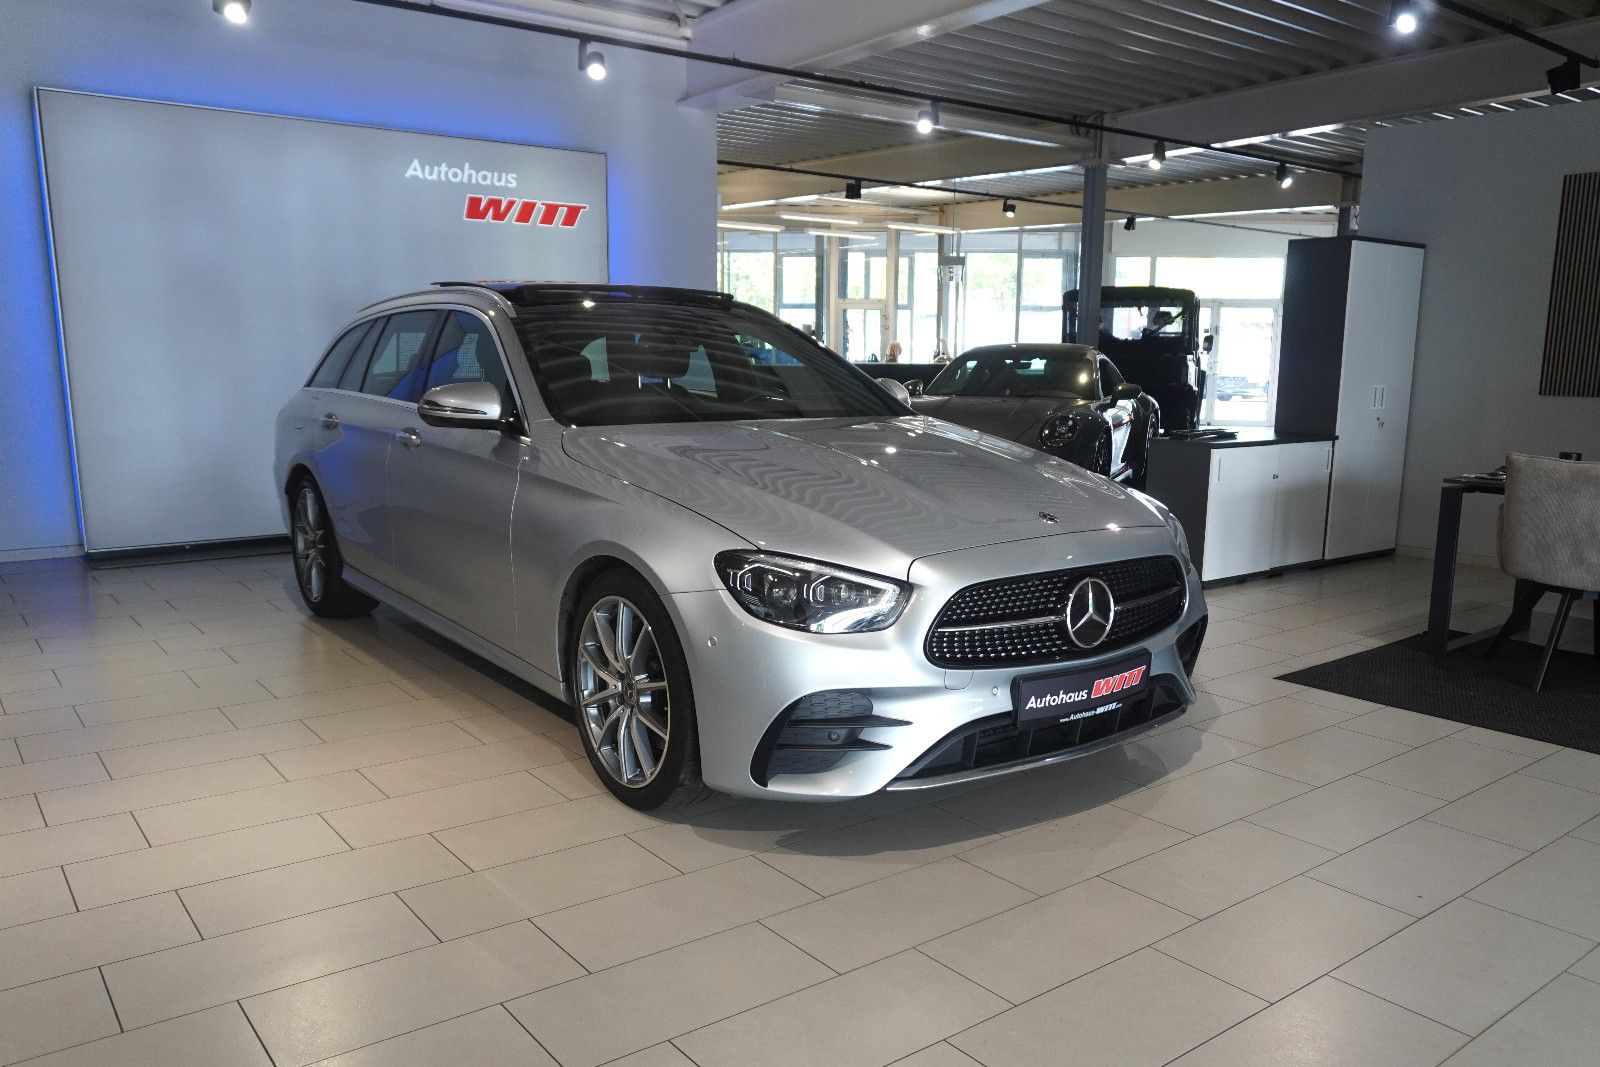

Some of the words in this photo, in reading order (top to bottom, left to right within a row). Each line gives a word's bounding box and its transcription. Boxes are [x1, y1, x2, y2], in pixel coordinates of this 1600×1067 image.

[405, 158, 518, 188] Autohaus
[463, 194, 588, 229] WITT
[1025, 689, 1088, 710] Autohaus
[1090, 665, 1147, 699] WITT
